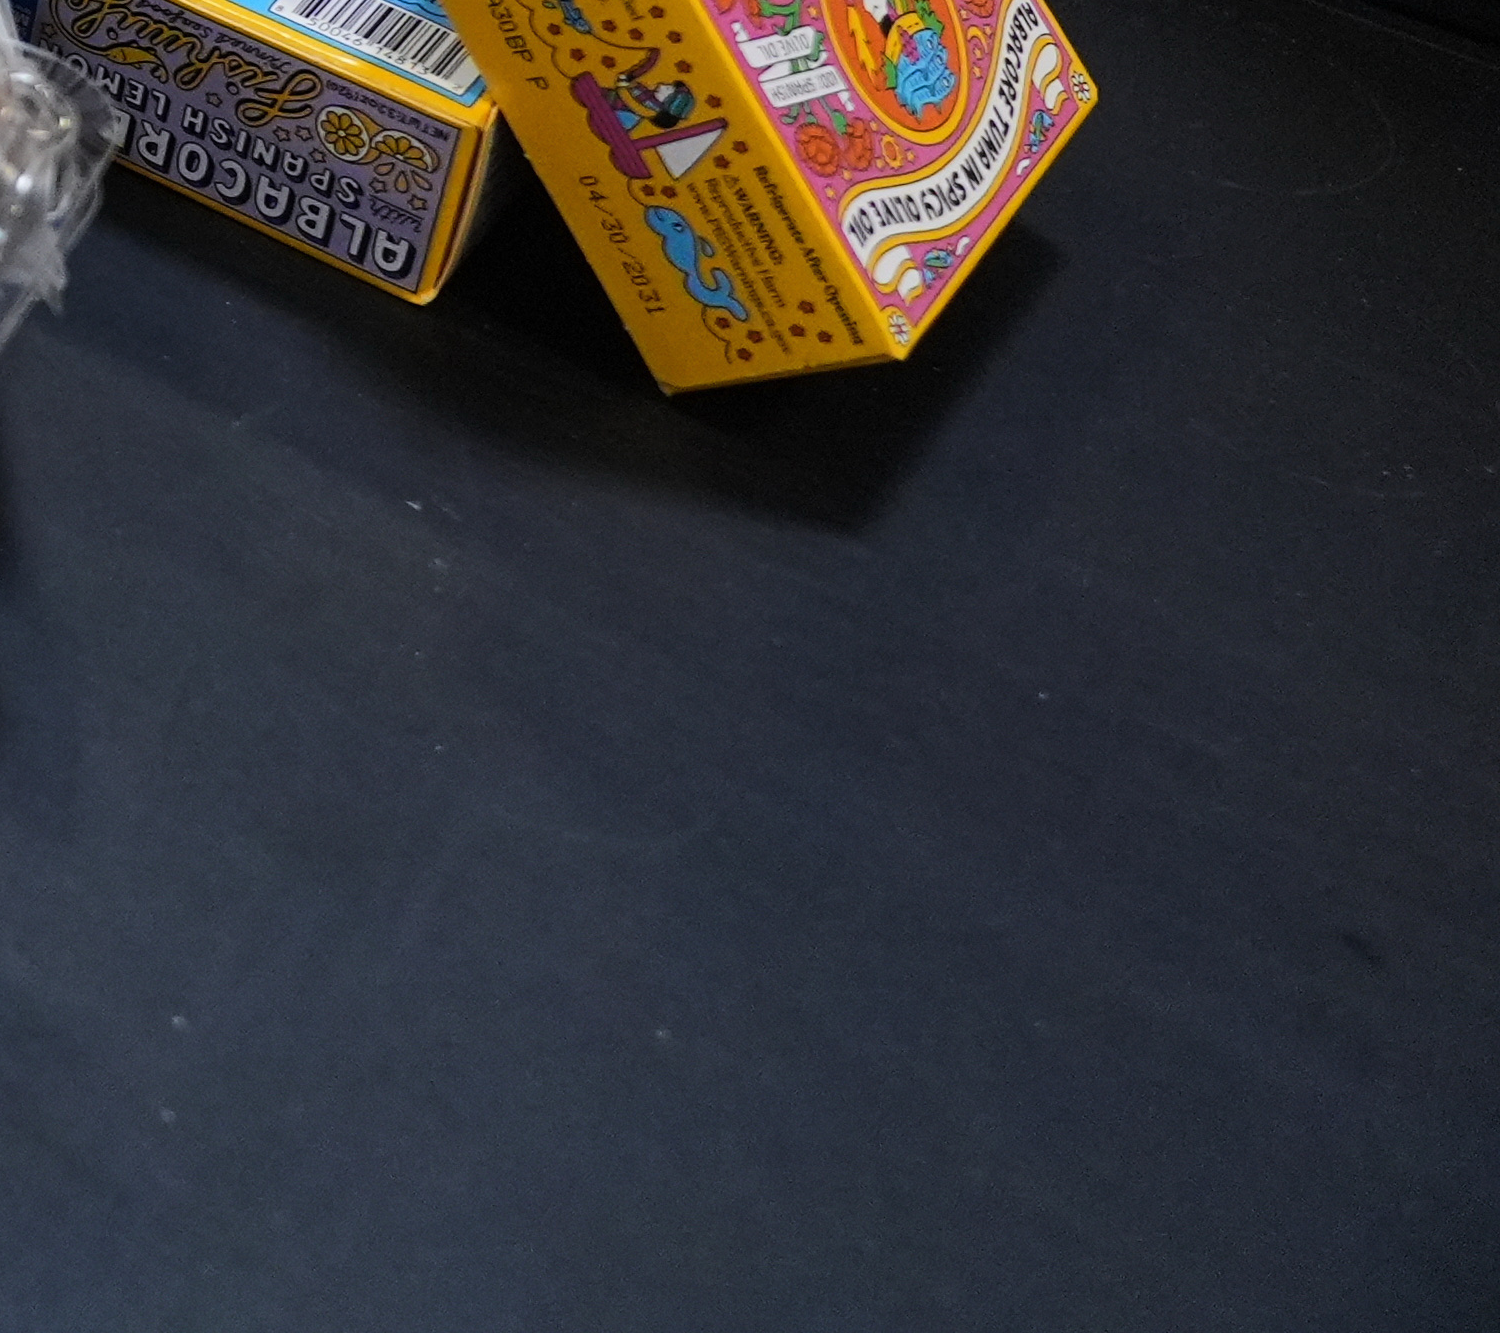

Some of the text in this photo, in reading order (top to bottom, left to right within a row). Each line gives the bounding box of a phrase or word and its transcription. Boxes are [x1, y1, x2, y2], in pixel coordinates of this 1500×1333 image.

[525, 75, 551, 92] P
[846, 1, 1039, 250] ALBACORE TUNA IN SPICY OLIVE OIL
[181, 103, 367, 211] SPANISH
[578, 174, 666, 316] 04/30/2031
[703, 177, 787, 310] Reproductive Harm
[733, 186, 784, 266] WARNING:
[752, 164, 866, 347] Refrigerate After Opening
